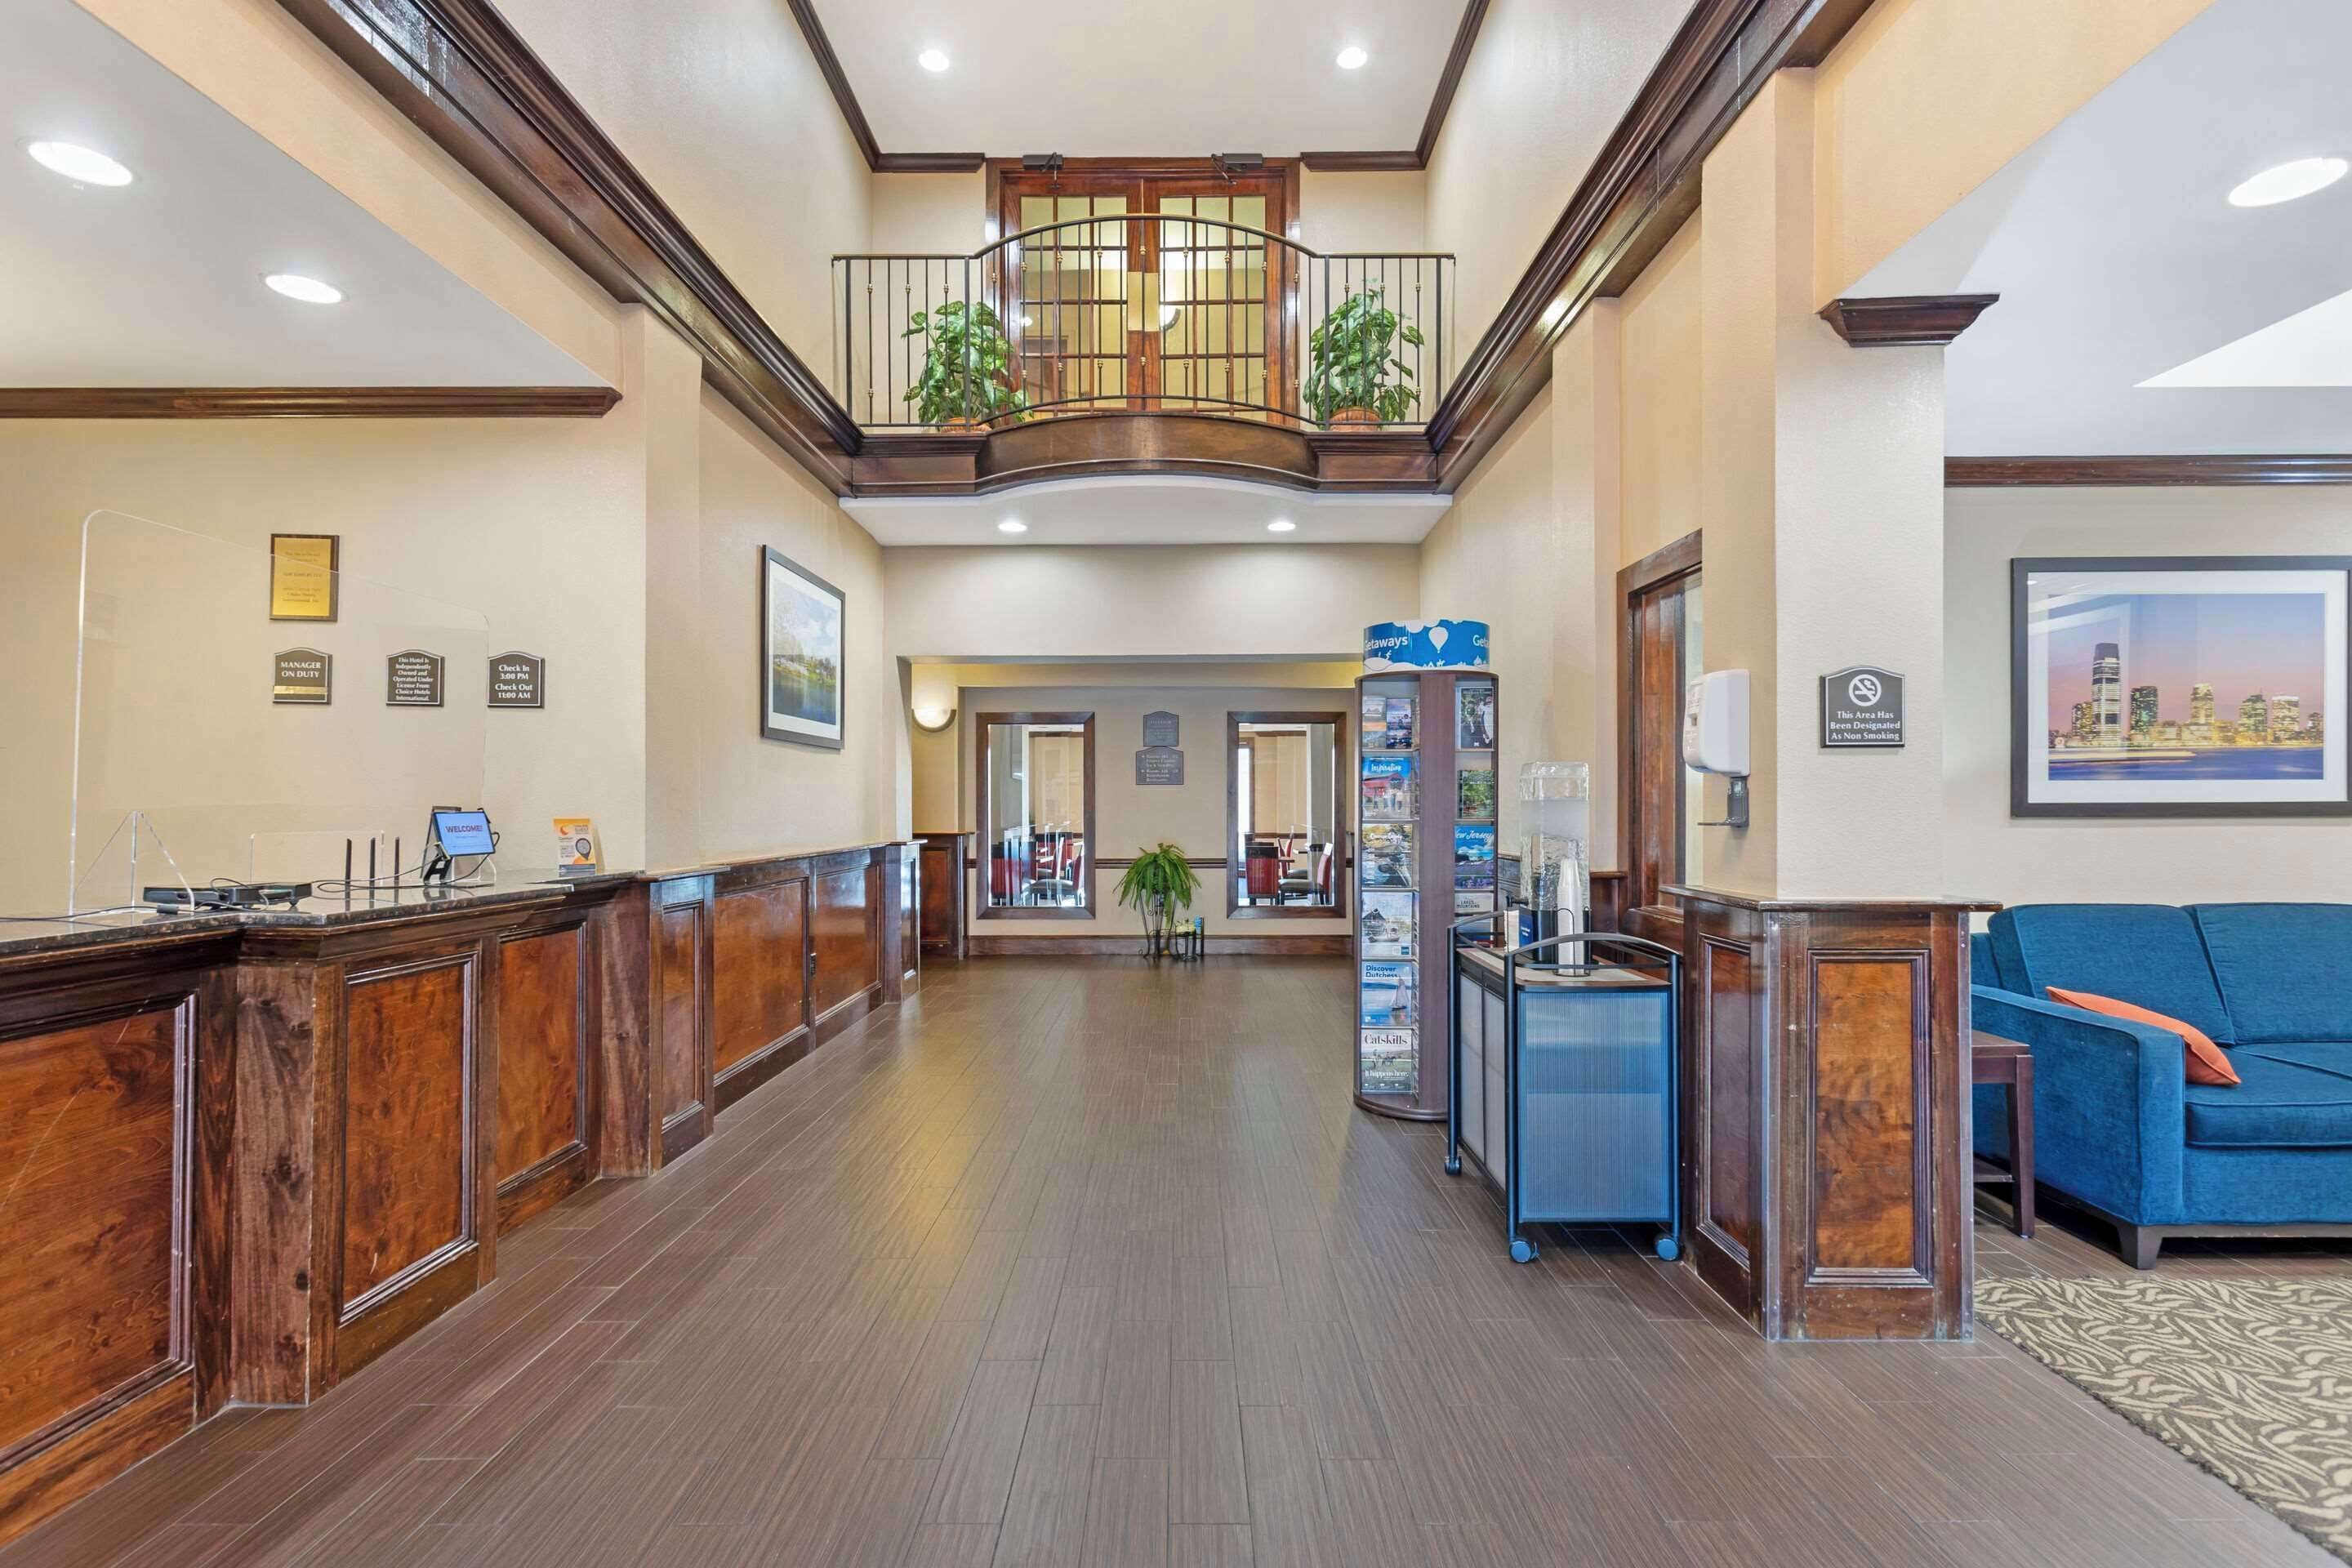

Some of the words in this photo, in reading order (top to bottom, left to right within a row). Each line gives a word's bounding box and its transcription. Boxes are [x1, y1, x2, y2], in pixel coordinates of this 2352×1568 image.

[1853, 721, 1901, 731] Designated
[1863, 731, 1900, 741] Smoking
[1371, 763, 1402, 773] Inspiration
[1467, 830, 1492, 842] Jersey
[1365, 1034, 1408, 1045] Catskills
[1370, 1070, 1394, 1078] happens
